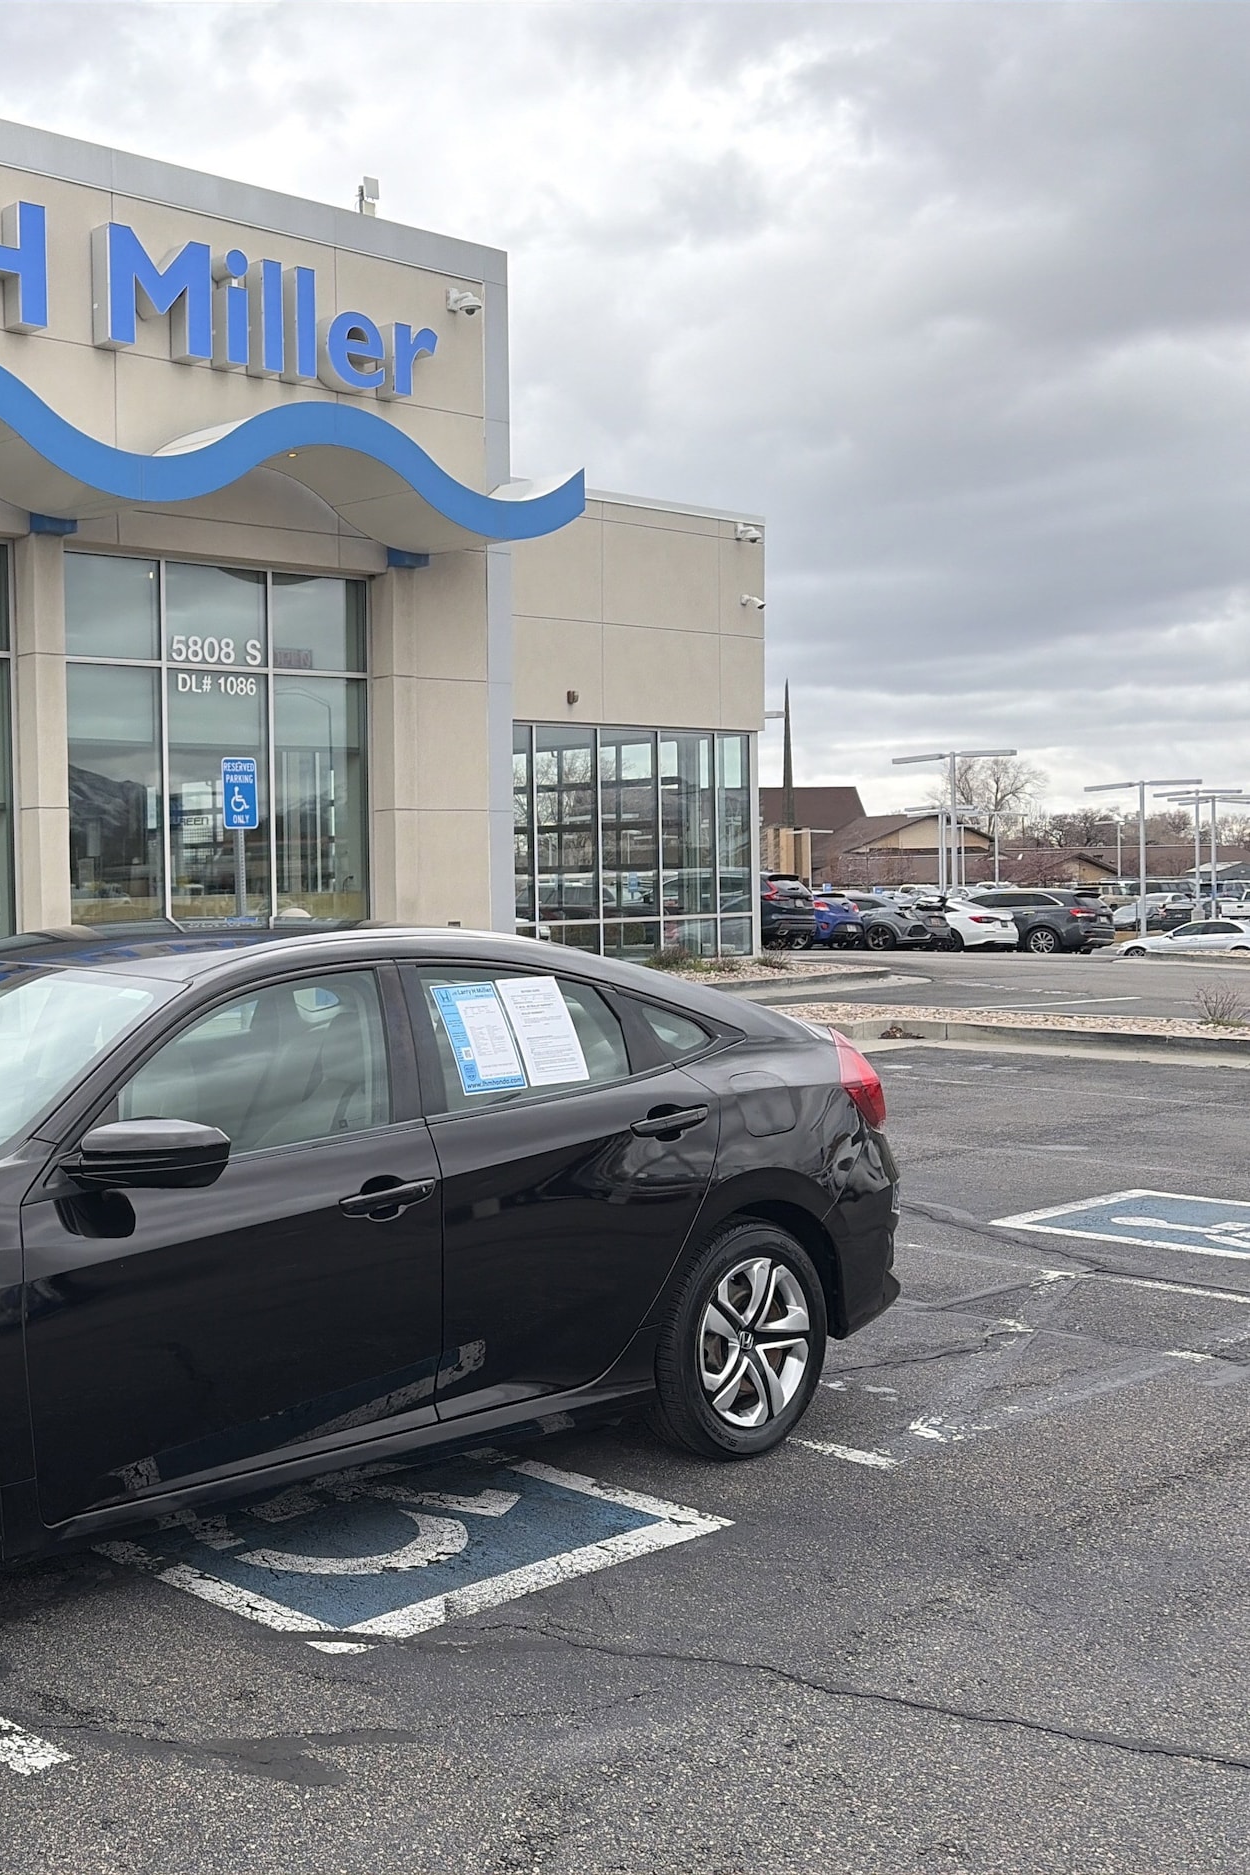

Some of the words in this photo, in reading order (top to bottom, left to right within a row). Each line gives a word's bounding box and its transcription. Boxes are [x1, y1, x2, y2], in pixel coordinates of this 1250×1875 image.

[93, 222, 438, 400] Miller
[171, 635, 235, 664] 5808
[245, 639, 262, 666] S
[177, 673, 212, 693] DL#
[217, 676, 257, 696] 1086
[223, 762, 255, 772] RESERVED
[225, 774, 254, 784] PARKING
[232, 814, 250, 824] ONLY
